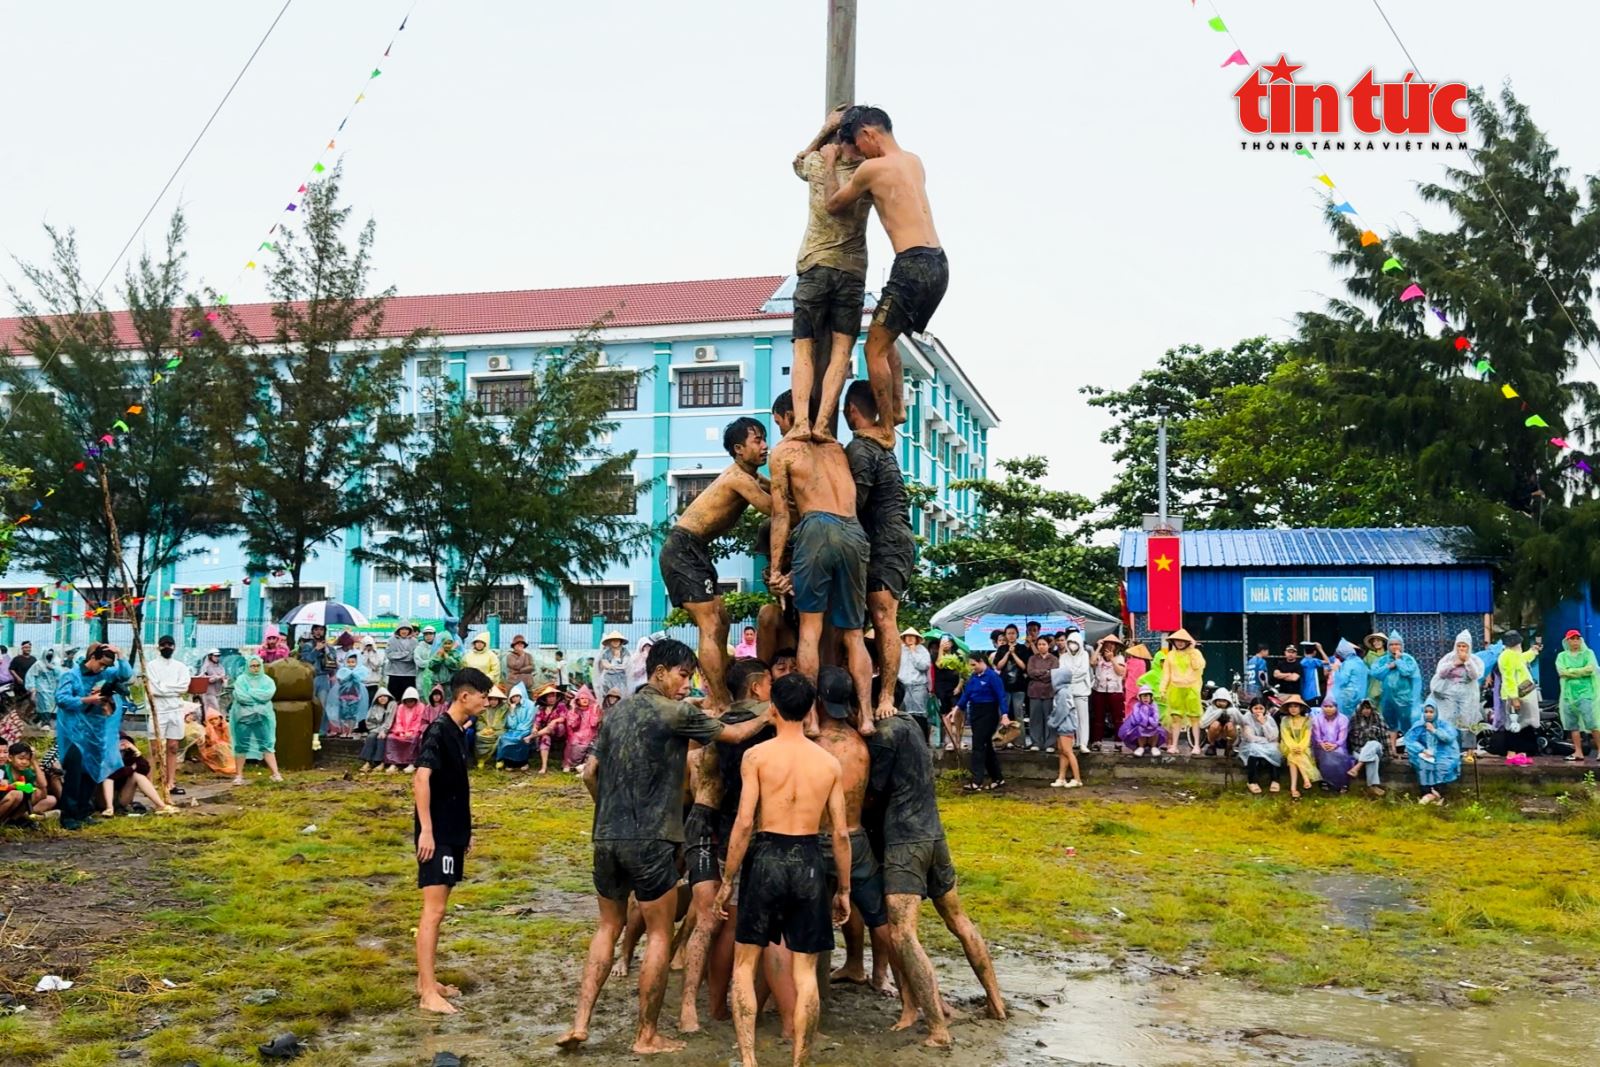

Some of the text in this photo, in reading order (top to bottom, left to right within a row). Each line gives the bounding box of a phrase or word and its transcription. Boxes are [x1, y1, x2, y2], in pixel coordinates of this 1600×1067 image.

[1250, 583, 1368, 606] NHÀ VỆ SINH CÔNG CỘNG
